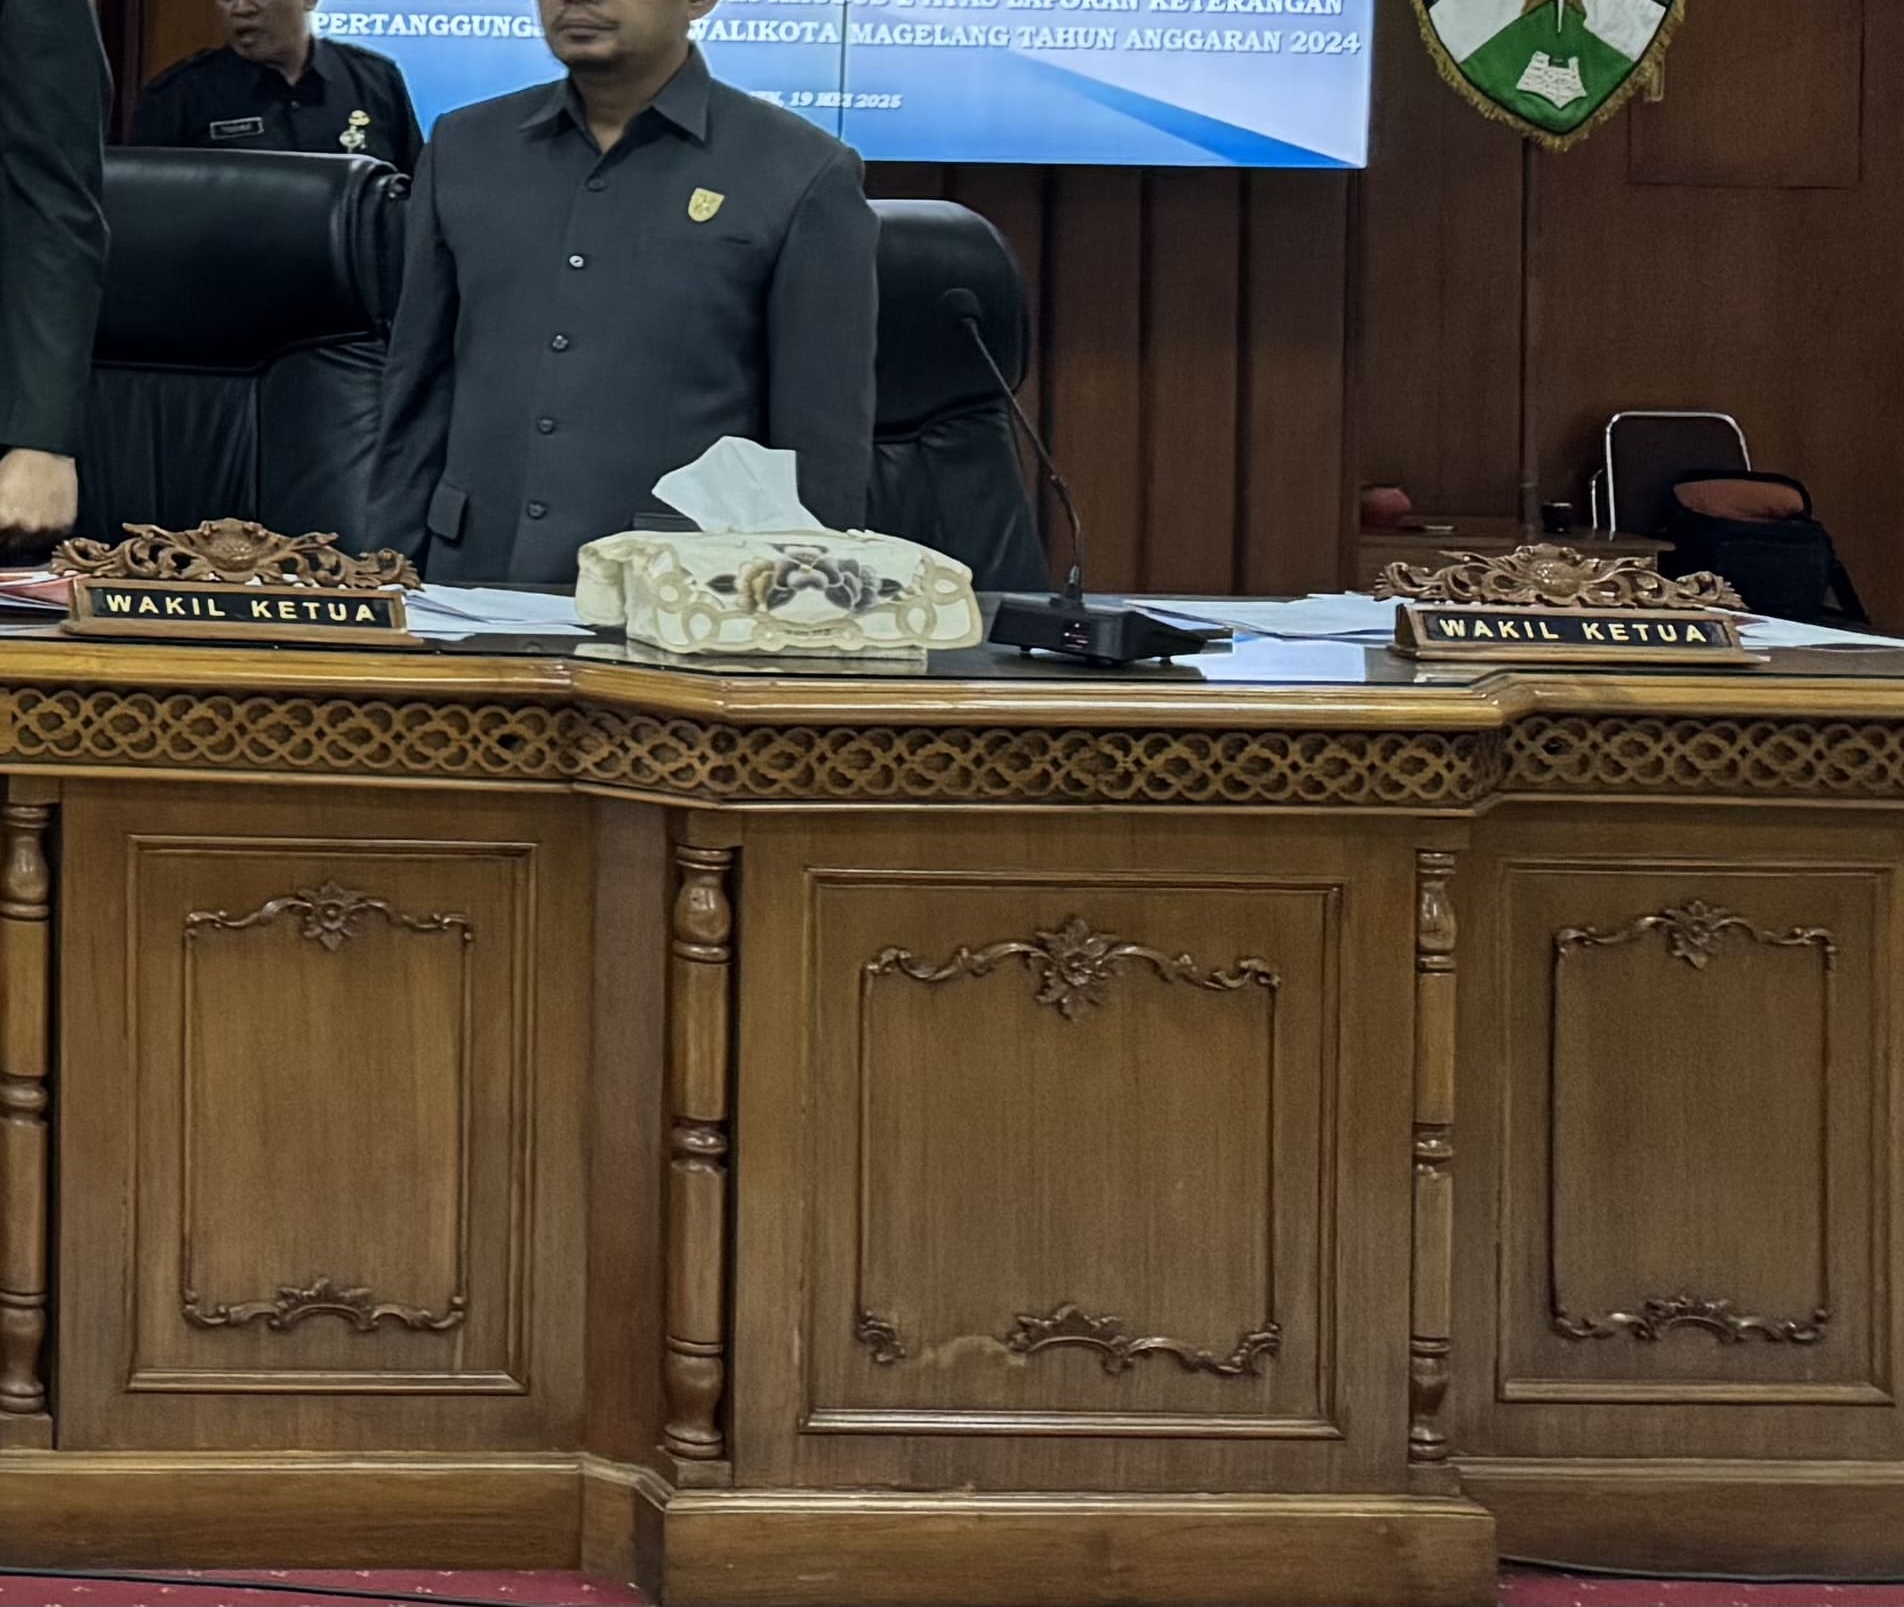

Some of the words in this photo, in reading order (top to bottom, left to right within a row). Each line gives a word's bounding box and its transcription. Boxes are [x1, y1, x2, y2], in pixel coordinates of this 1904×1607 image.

[851, 23, 1009, 48] MAGELANG
[1016, 26, 1116, 51] TAHUN
[1124, 28, 1280, 53] ANGGARAN
[1289, 31, 1361, 55] 2024
[790, 92, 813, 106] 19
[106, 594, 226, 617] WAKIL
[251, 600, 376, 622] KETUA
[1440, 619, 1559, 640] WAKIL
[1582, 622, 1707, 643] KETUA
